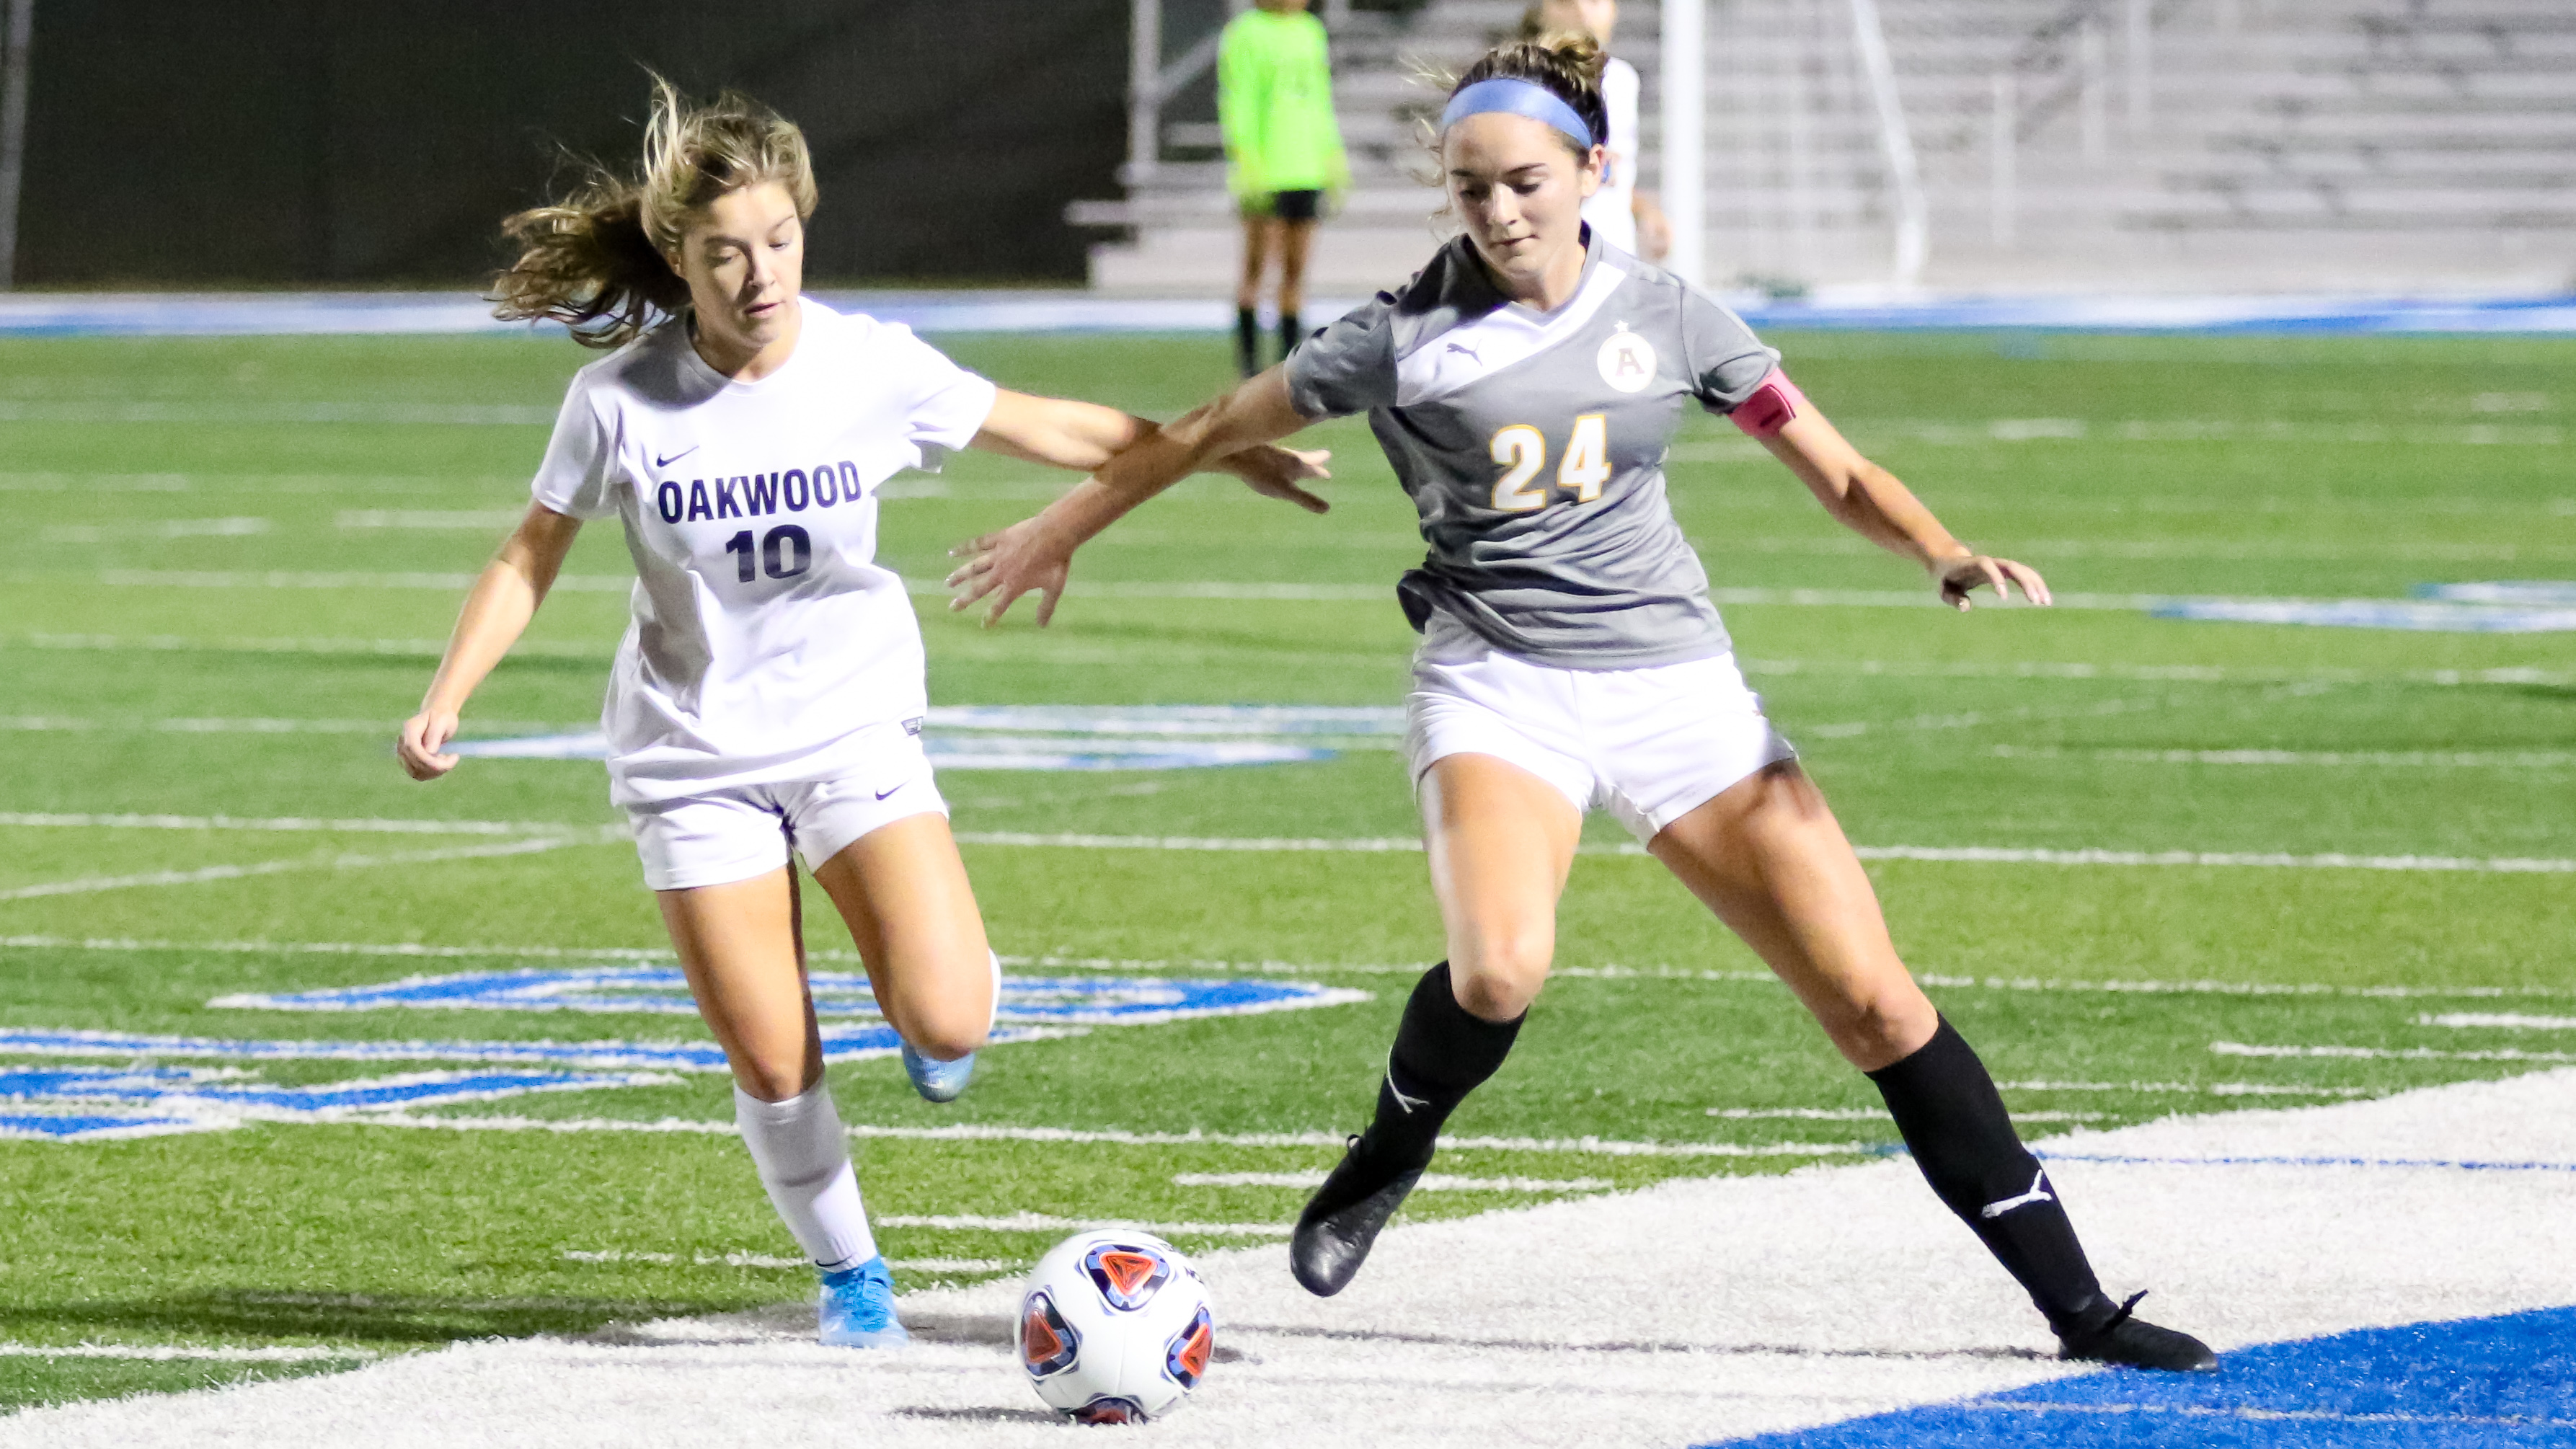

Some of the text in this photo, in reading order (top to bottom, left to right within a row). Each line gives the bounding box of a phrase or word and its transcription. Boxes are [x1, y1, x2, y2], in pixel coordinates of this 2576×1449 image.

[1615, 347, 1645, 376] A
[658, 460, 862, 524] OAKWOOD
[1490, 414, 1612, 513] 24
[725, 524, 811, 582] 10
